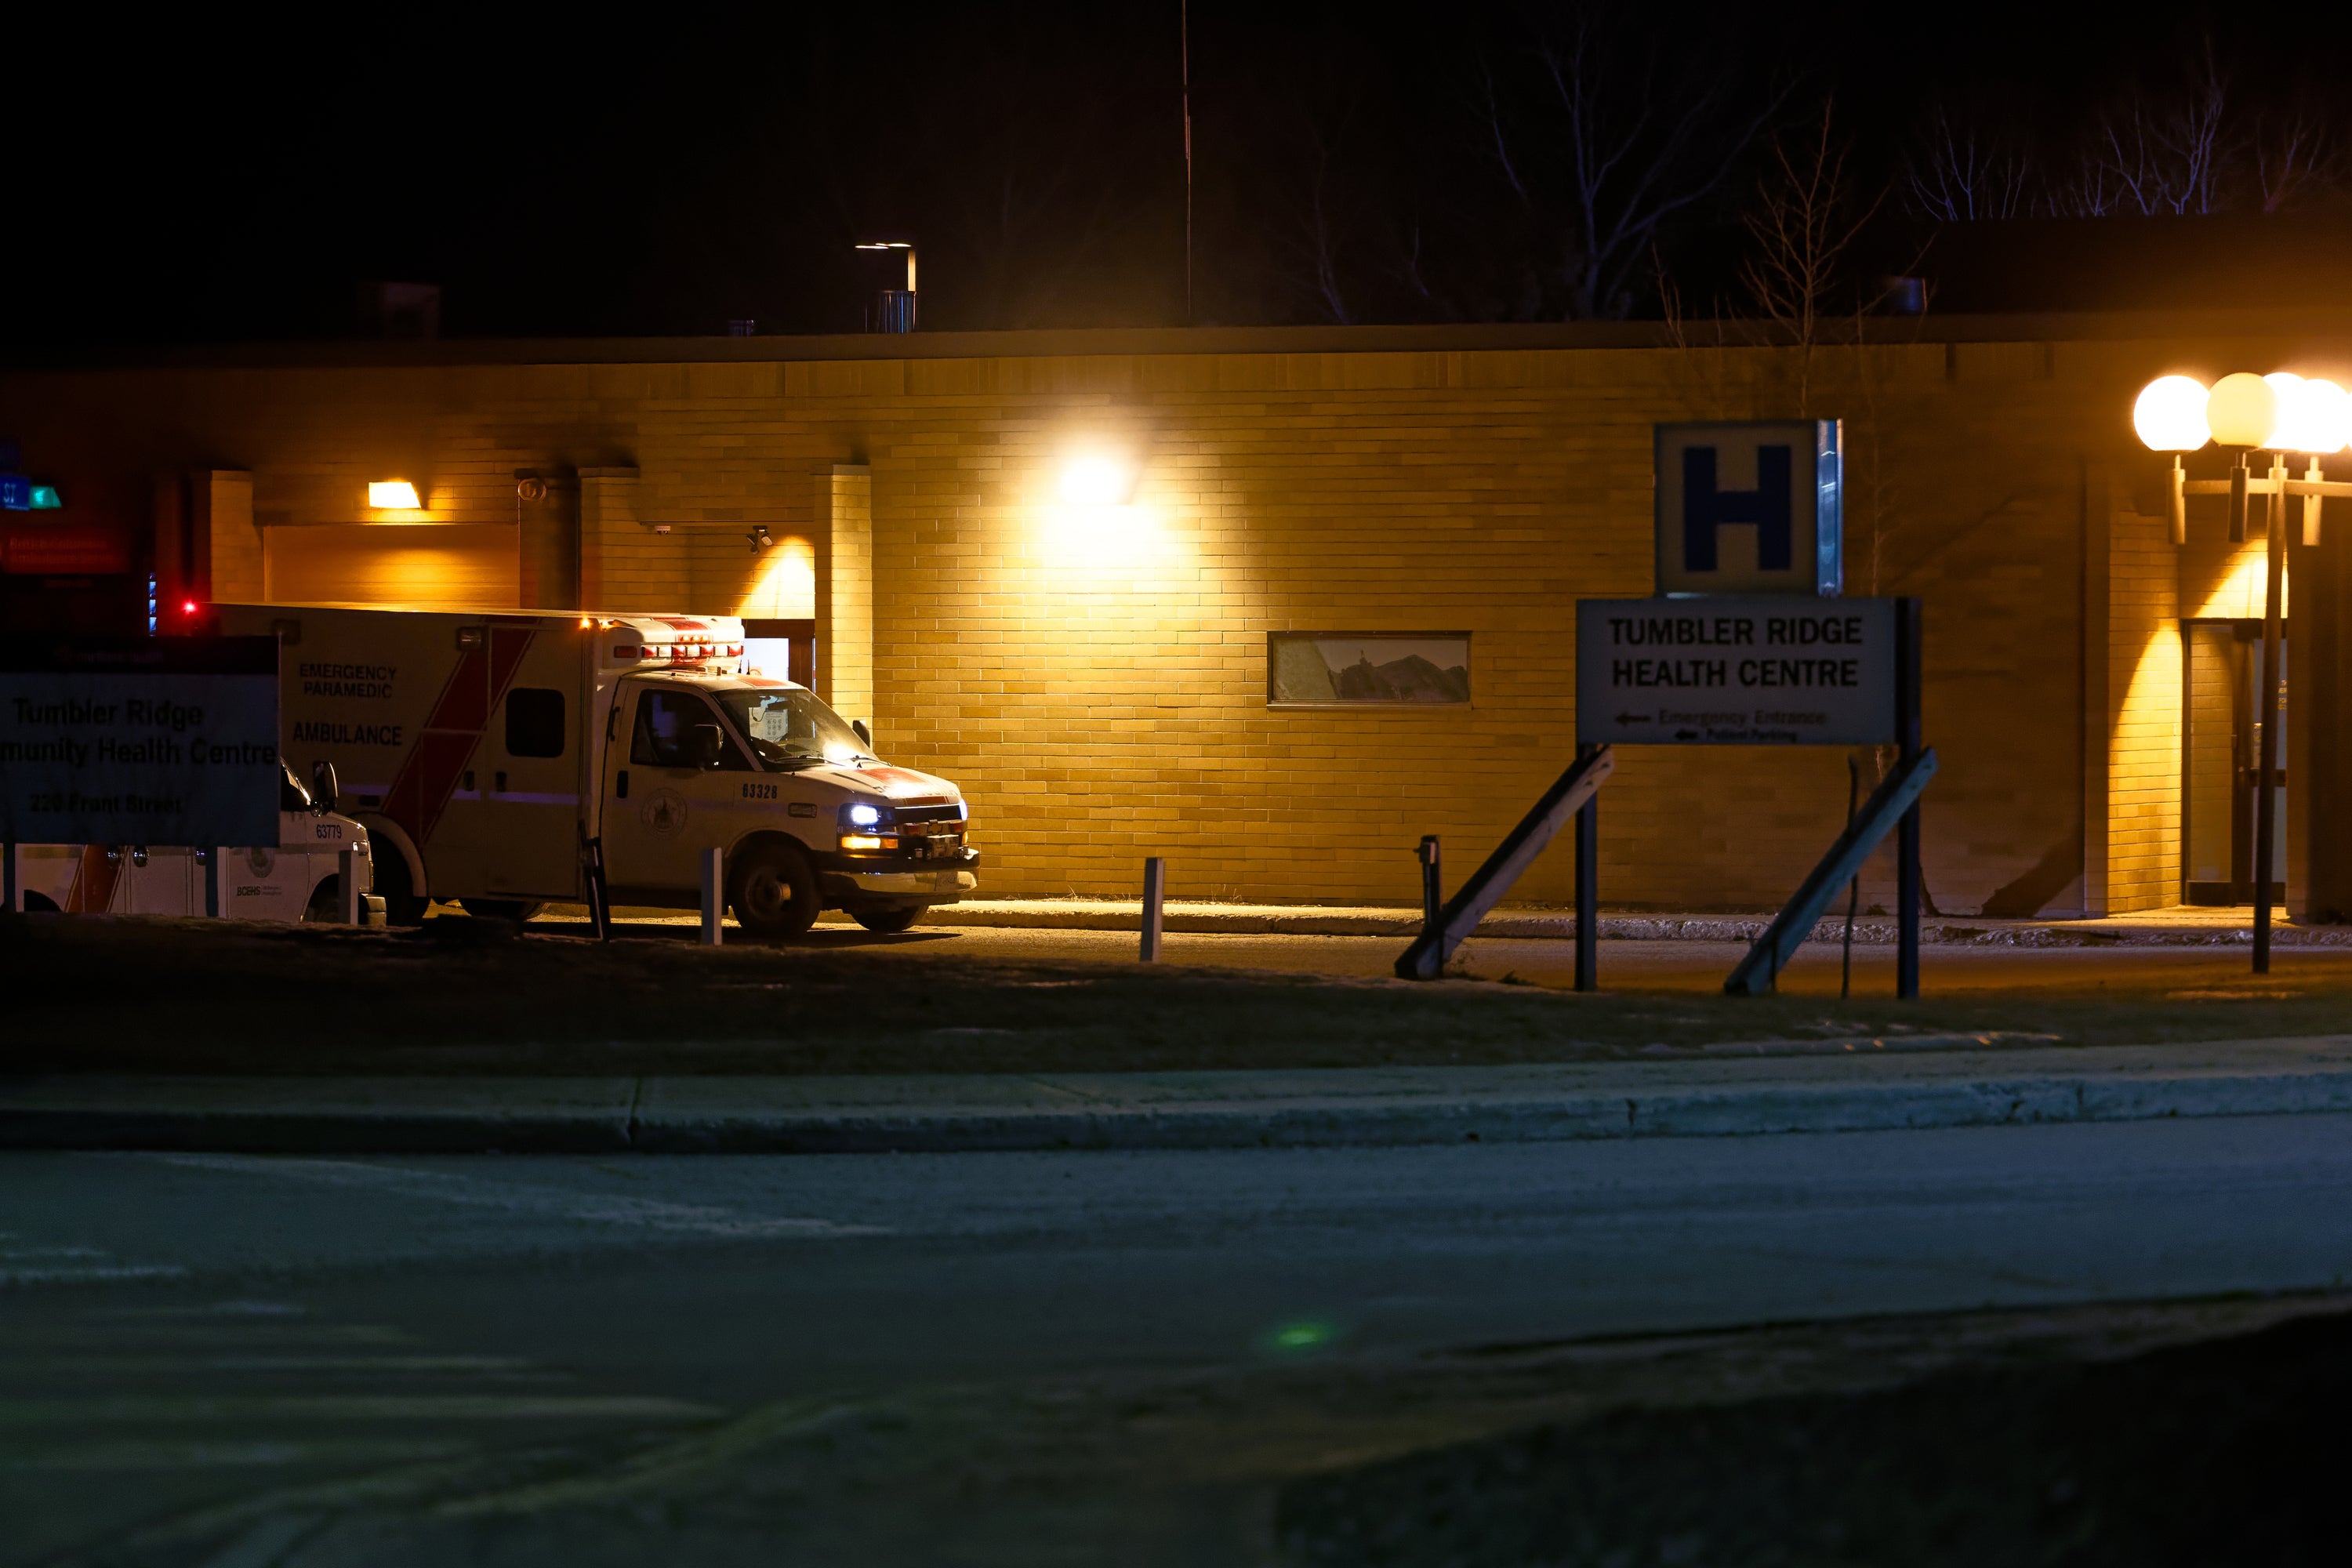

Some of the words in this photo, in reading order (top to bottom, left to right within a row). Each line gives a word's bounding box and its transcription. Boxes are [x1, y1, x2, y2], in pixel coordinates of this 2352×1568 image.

[1684, 446, 1791, 571] H
[1610, 619, 1753, 644] TUMBLER
[1768, 618, 1863, 644] RIDGE
[299, 663, 397, 681] EMERGENCY
[1613, 660, 1726, 686] HEALTH
[1739, 660, 1858, 686] CENTRE
[304, 682, 393, 698] PARAMEDIC
[13, 698, 117, 724] Tumbler
[126, 699, 203, 731] Ridge
[1659, 710, 1748, 727] Emergency
[1755, 710, 1827, 724] Entrance
[293, 722, 402, 746] AMBULANCE
[99, 739, 180, 765] Health
[191, 739, 276, 765] Centre
[742, 783, 778, 799] 63328
[31, 793, 63, 812] 220
[69, 792, 119, 812] Front
[316, 824, 343, 839] 63779
[237, 886, 261, 896] BCEHS
